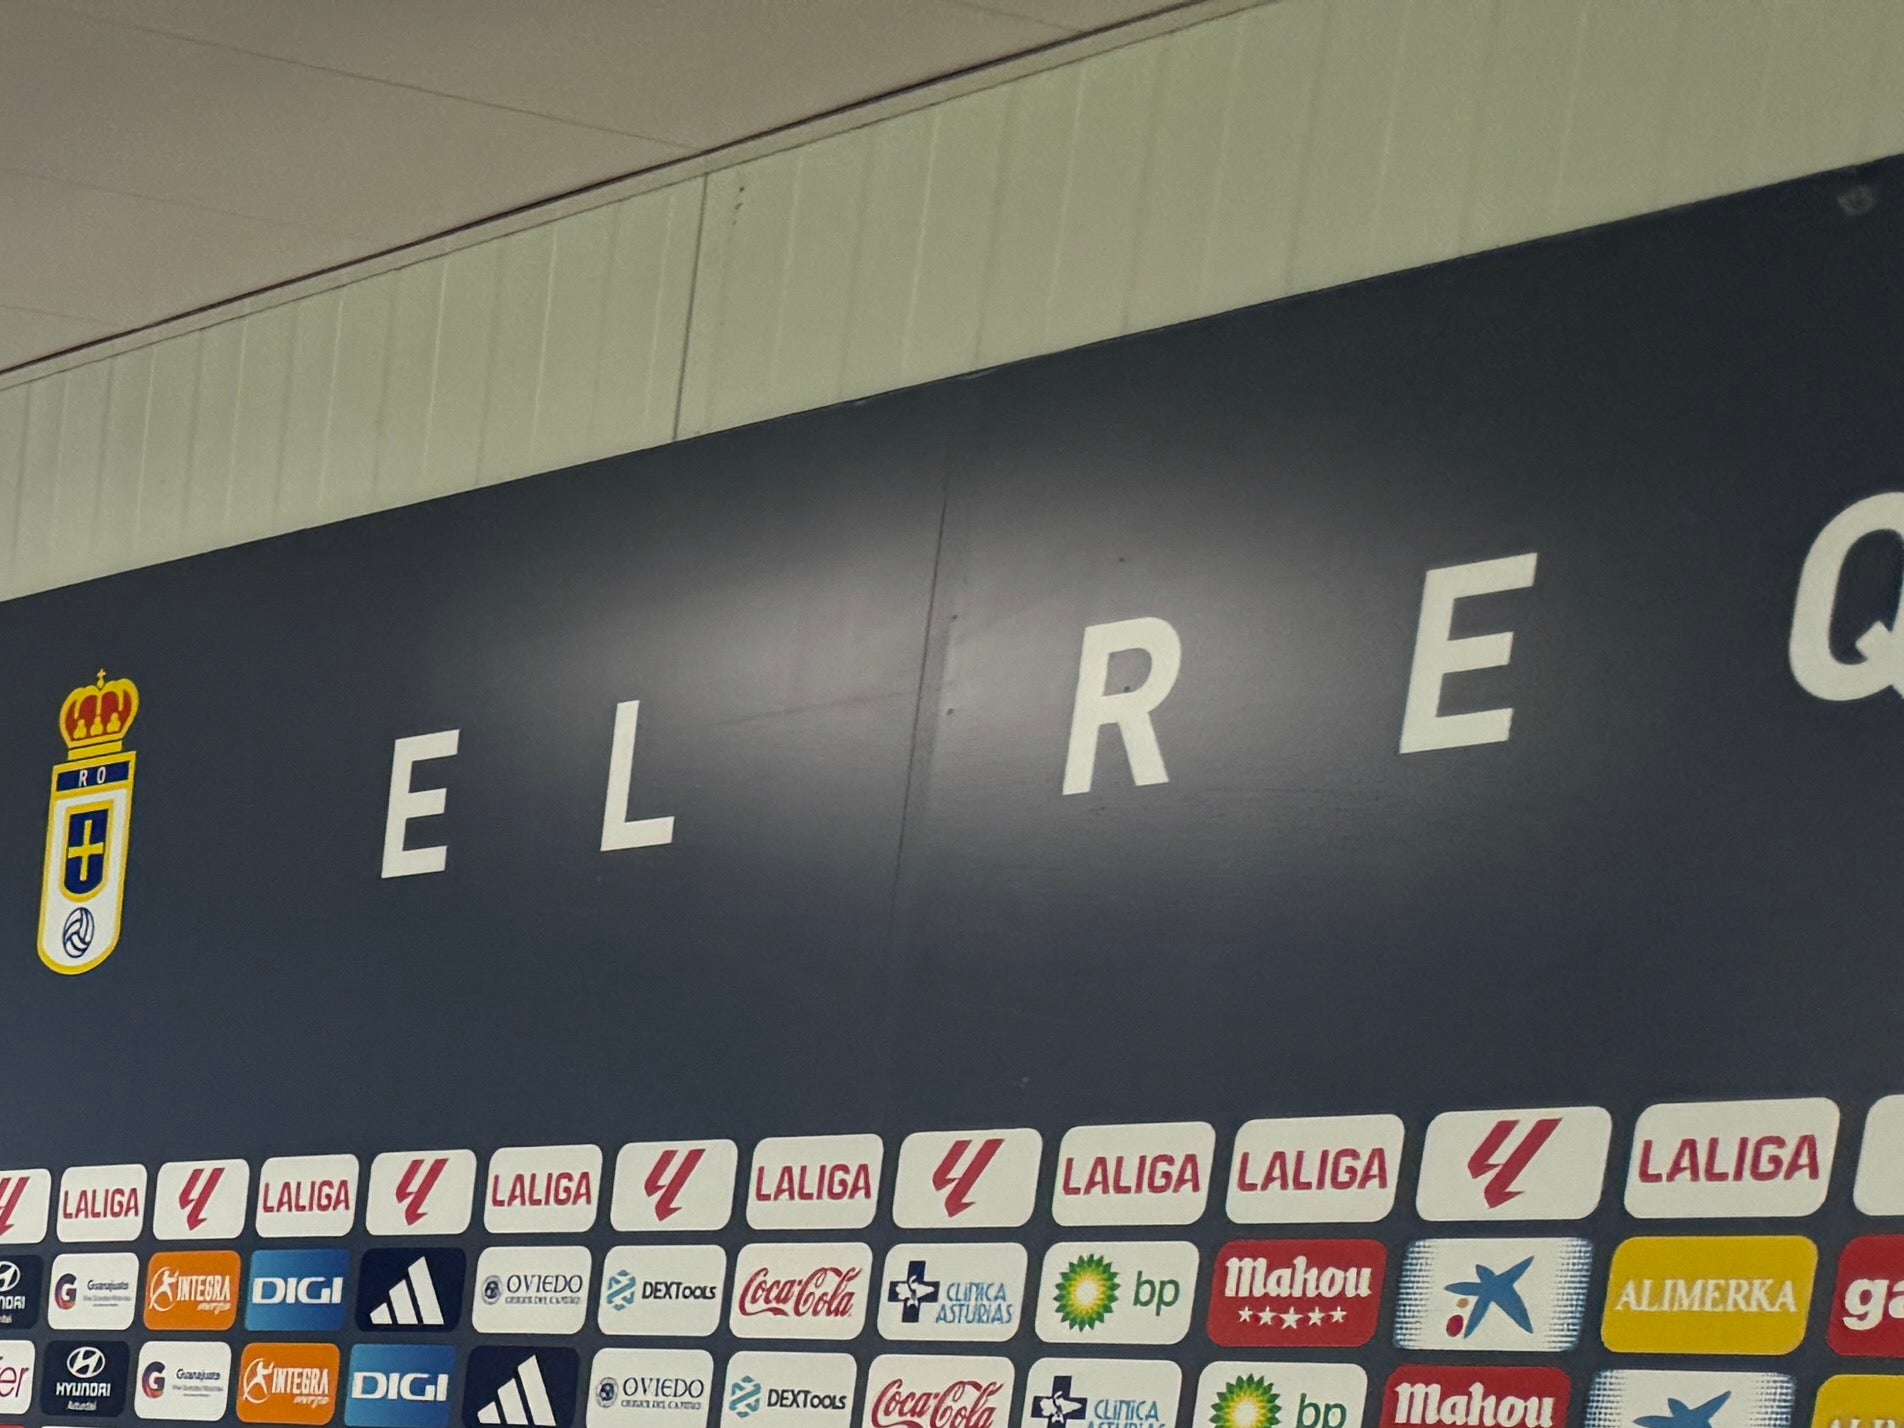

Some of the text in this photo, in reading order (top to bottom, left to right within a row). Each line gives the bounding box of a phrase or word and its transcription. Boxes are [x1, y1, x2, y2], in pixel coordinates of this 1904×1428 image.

[1063, 1154, 1200, 1195] LALIGA
[1238, 1148, 1387, 1191] LALIGA
[1639, 1135, 1819, 1183] LALIGA
[263, 1180, 349, 1212] LALIGA
[492, 1172, 591, 1207] LALIGA
[756, 1164, 871, 1201] LALIGA
[248, 1277, 343, 1304] DIGI
[507, 1275, 583, 1293] OVIEDO
[739, 1267, 862, 1317] Coca-Cola
[1133, 1271, 1179, 1316] bp
[1225, 1256, 1371, 1297] Mahou
[1618, 1279, 1797, 1312] ALIMERKA
[1395, 1382, 1554, 1428] Mahou
